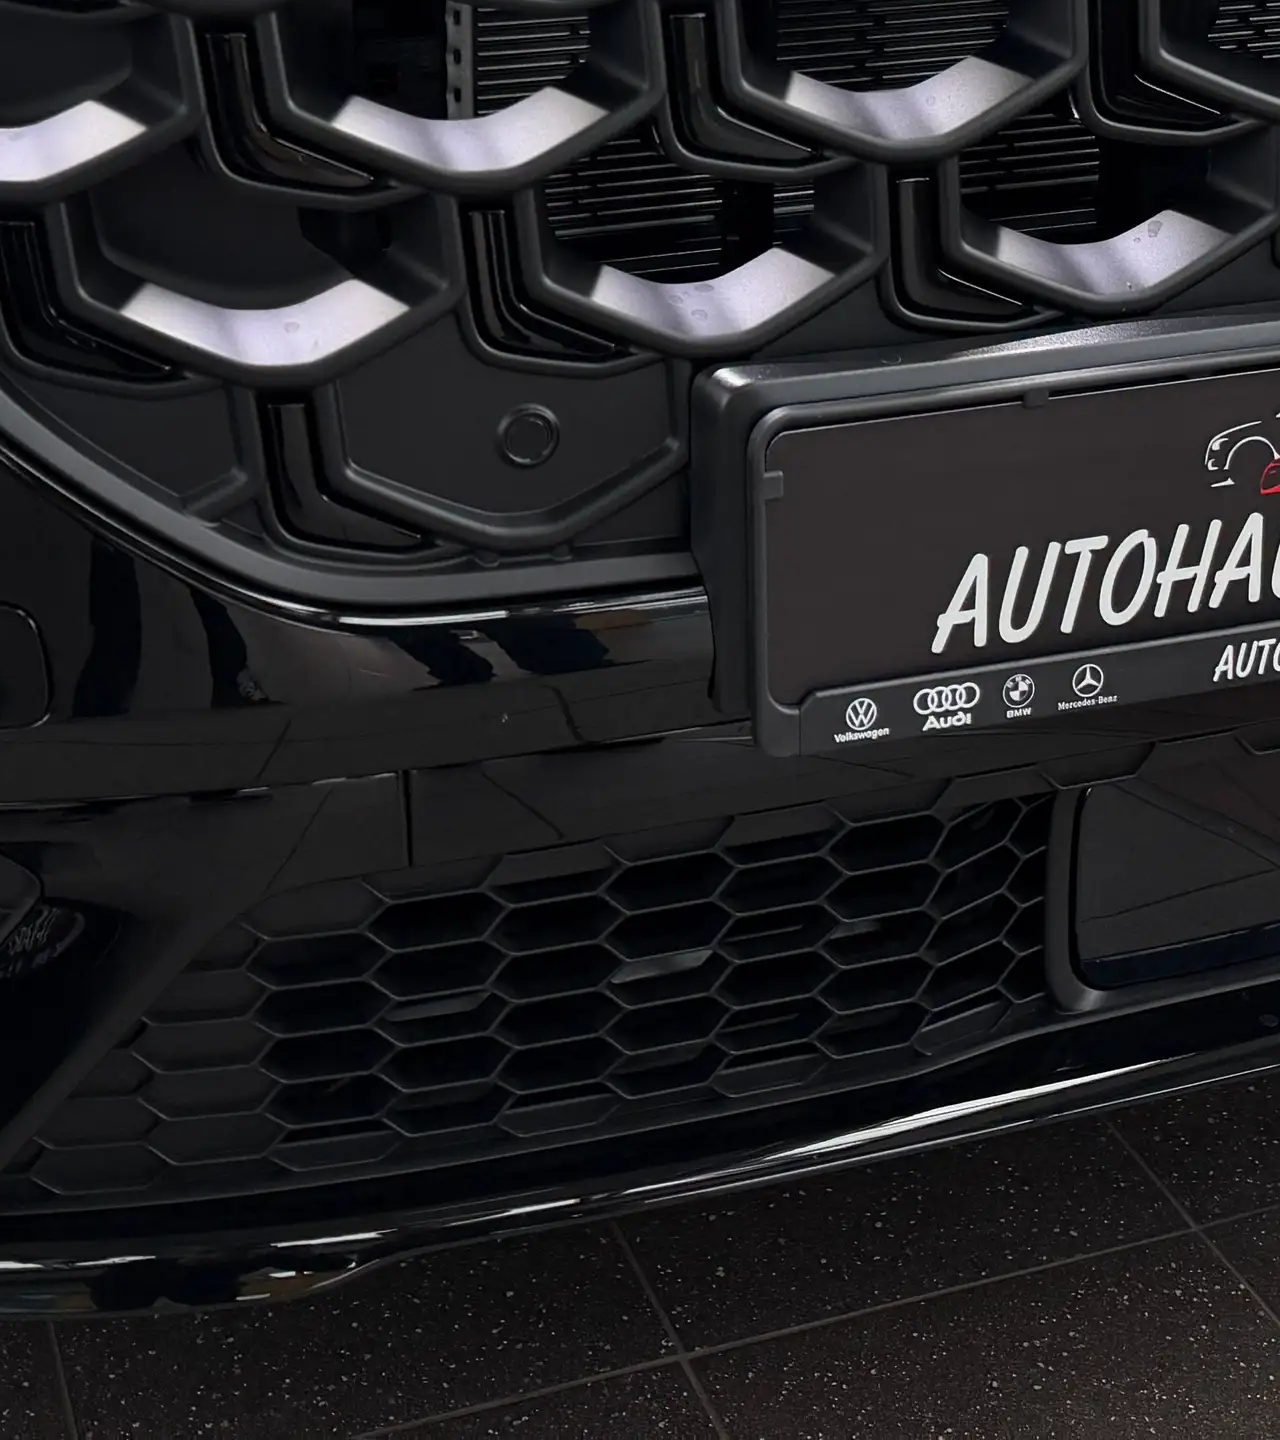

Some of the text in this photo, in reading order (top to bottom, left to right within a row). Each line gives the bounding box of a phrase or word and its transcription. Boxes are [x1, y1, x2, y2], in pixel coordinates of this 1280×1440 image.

[1057, 694, 1118, 711] Mercedes-Benz
[1006, 707, 1032, 719] BMW
[922, 711, 972, 732] Audi
[833, 727, 890, 743] Volkswagen
